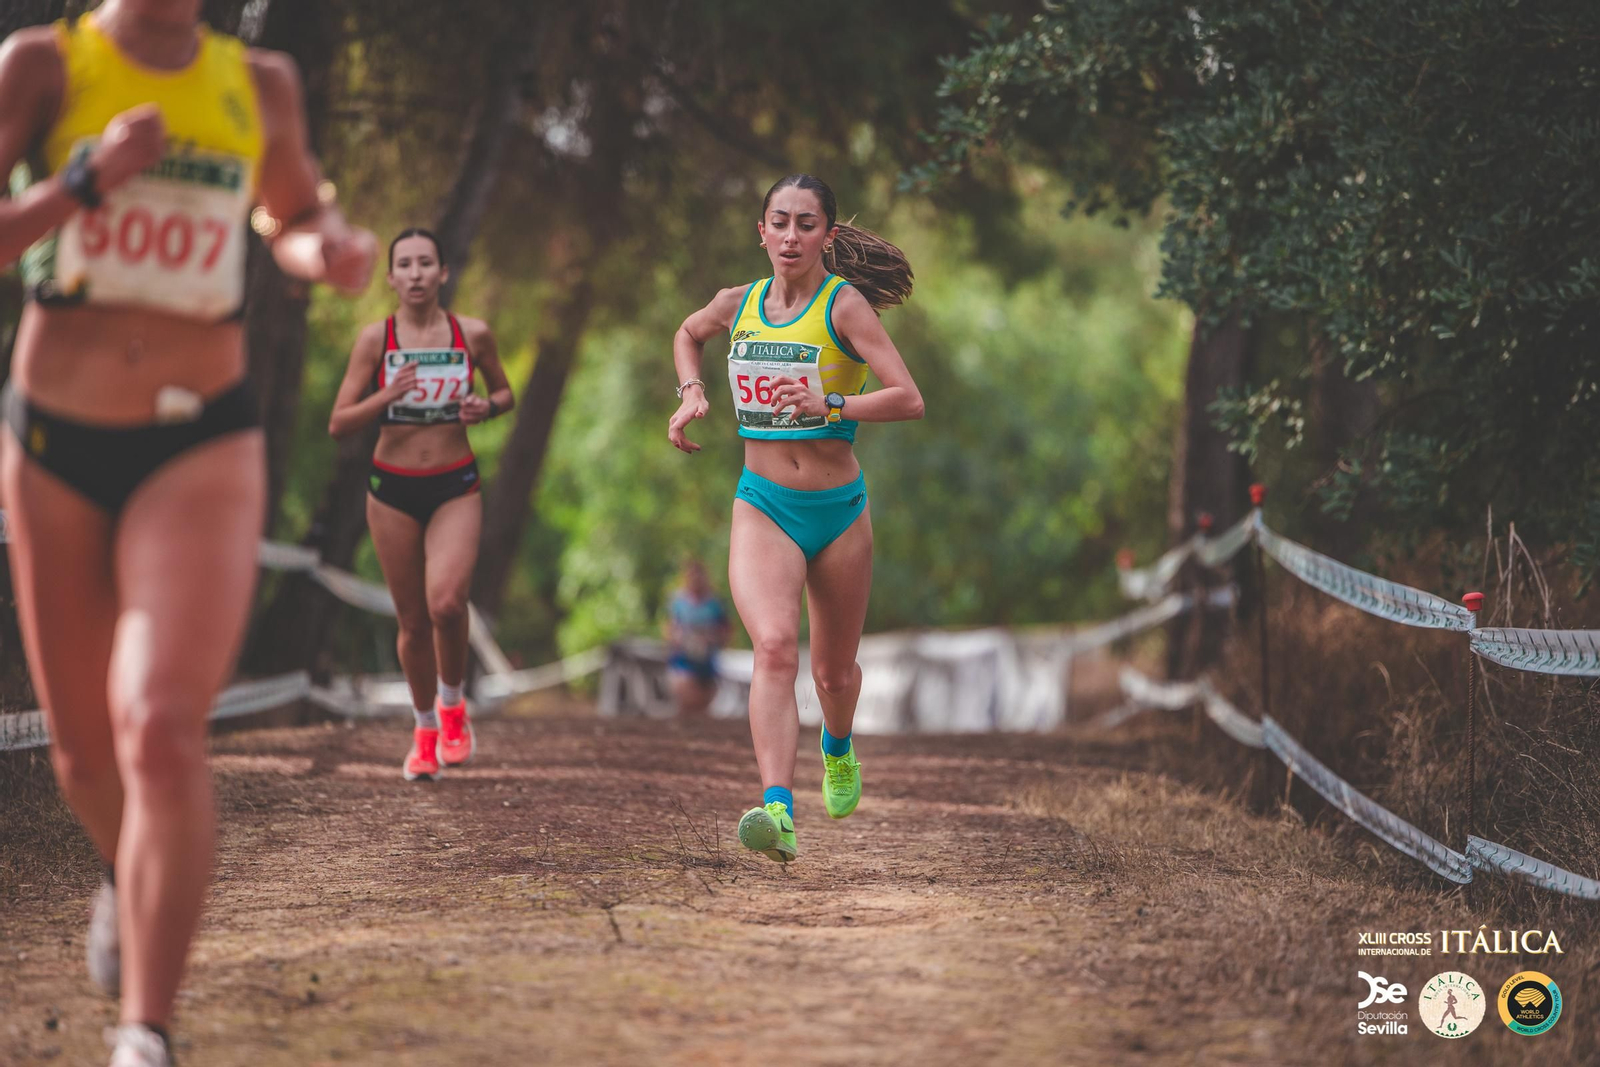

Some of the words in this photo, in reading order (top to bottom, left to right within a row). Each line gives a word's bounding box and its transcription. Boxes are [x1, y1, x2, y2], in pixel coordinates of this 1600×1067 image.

[80, 206, 230, 273] 5007
[752, 343, 794, 356] ITÁLICA
[736, 374, 809, 405] 56
